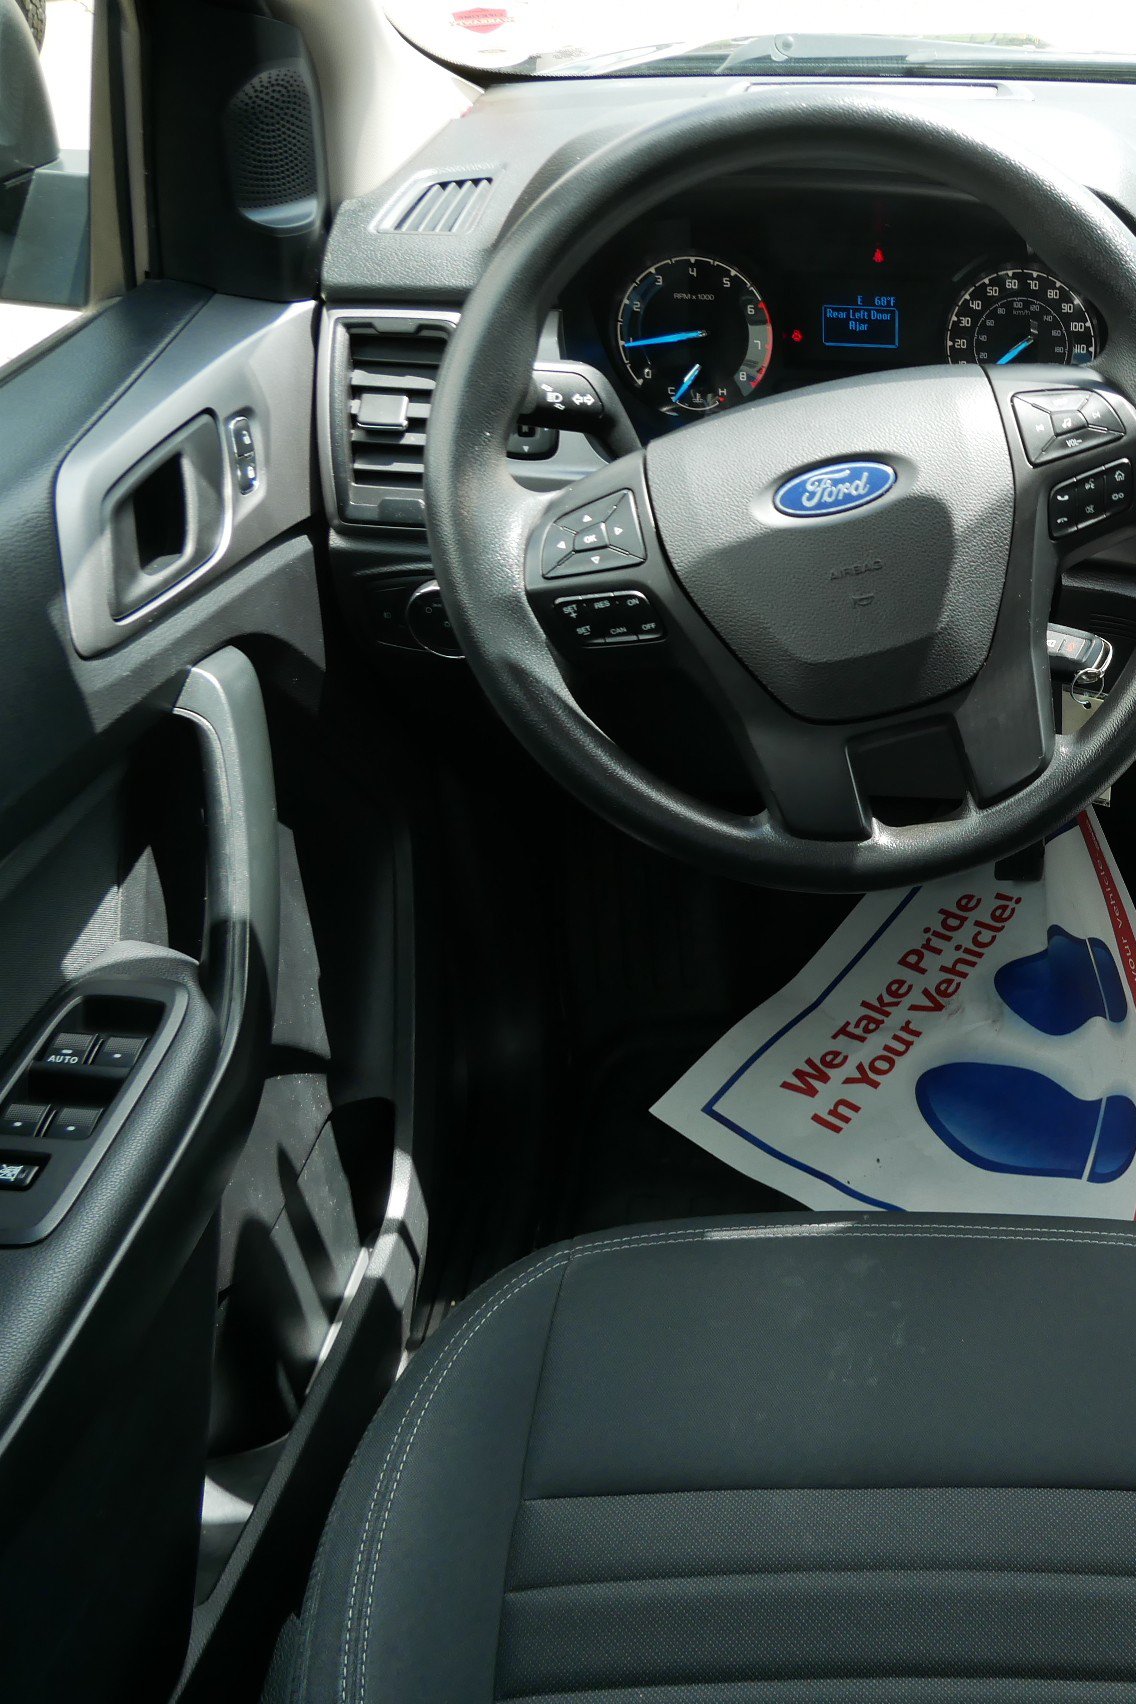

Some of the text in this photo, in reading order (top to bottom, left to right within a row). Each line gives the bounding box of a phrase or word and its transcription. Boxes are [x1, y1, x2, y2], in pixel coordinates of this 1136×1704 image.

[689, 268, 697, 277] 4
[655, 276, 663, 285] 3
[723, 278, 731, 288] 5
[1006, 280, 1018, 289] 60
[1027, 280, 1039, 290] 70
[673, 292, 691, 300] RPM
[697, 293, 715, 301] 1000
[987, 287, 999, 296] 50
[1047, 289, 1059, 299] 80
[857, 295, 863, 305] E
[969, 300, 982, 310] 40
[633, 302, 641, 311] 2
[747, 305, 755, 315] 6
[1061, 303, 1073, 313] 90
[826, 308, 891, 320] Rear Left Door
[849, 321, 868, 331] Ajar
[959, 317, 971, 327] 30
[1070, 322, 1085, 332] 100
[954, 339, 967, 349] 20
[739, 371, 747, 381] 8
[718, 388, 727, 396] H
[801, 469, 870, 508] Ford
[583, 534, 598, 544] OK
[829, 559, 883, 581] AIRBAG
[594, 600, 611, 610] RES
[626, 598, 640, 607] ON
[610, 627, 627, 635] CAN
[641, 622, 657, 631] OFF
[779, 893, 982, 1099] We Take Pride
[810, 892, 1023, 1134] In Your Vehicle!
[47, 1054, 79, 1064] AUTO
